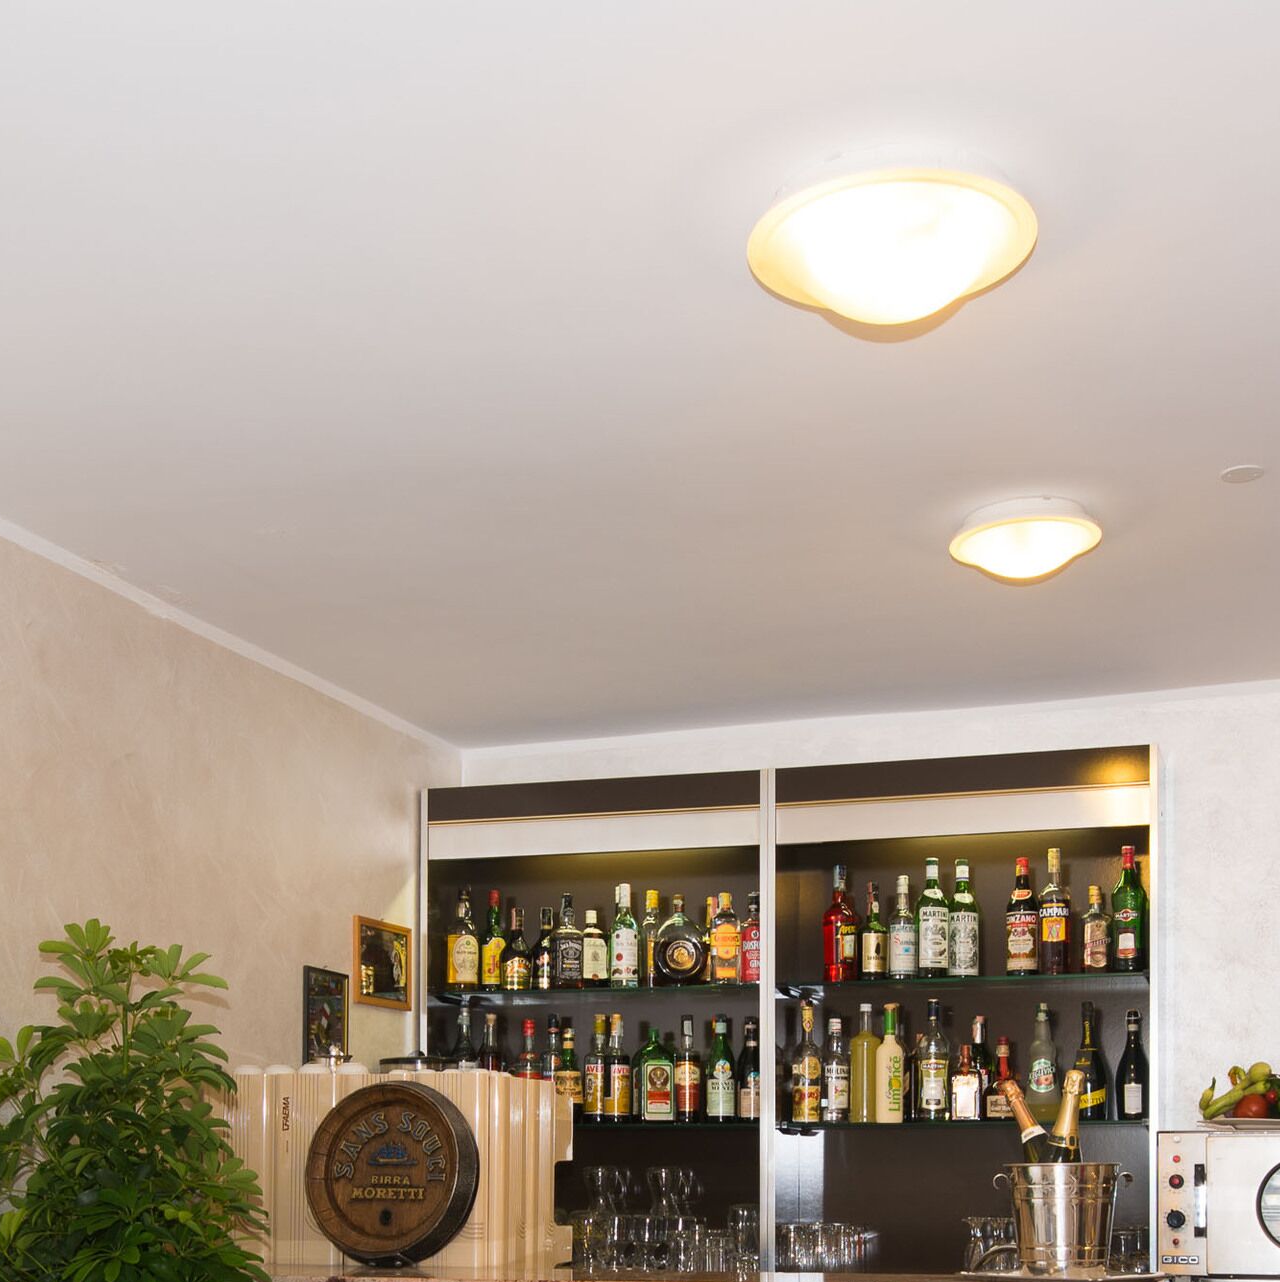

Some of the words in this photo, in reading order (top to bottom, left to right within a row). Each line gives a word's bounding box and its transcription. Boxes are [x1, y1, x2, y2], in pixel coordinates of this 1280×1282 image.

[1039, 907, 1069, 917] CAMPARI
[334, 1111, 389, 1179] SANS
[397, 1111, 447, 1183] SOUCI
[371, 1175, 411, 1186] BIRRA
[351, 1187, 426, 1200] MORETTI
[1162, 1256, 1199, 1264] GICO
